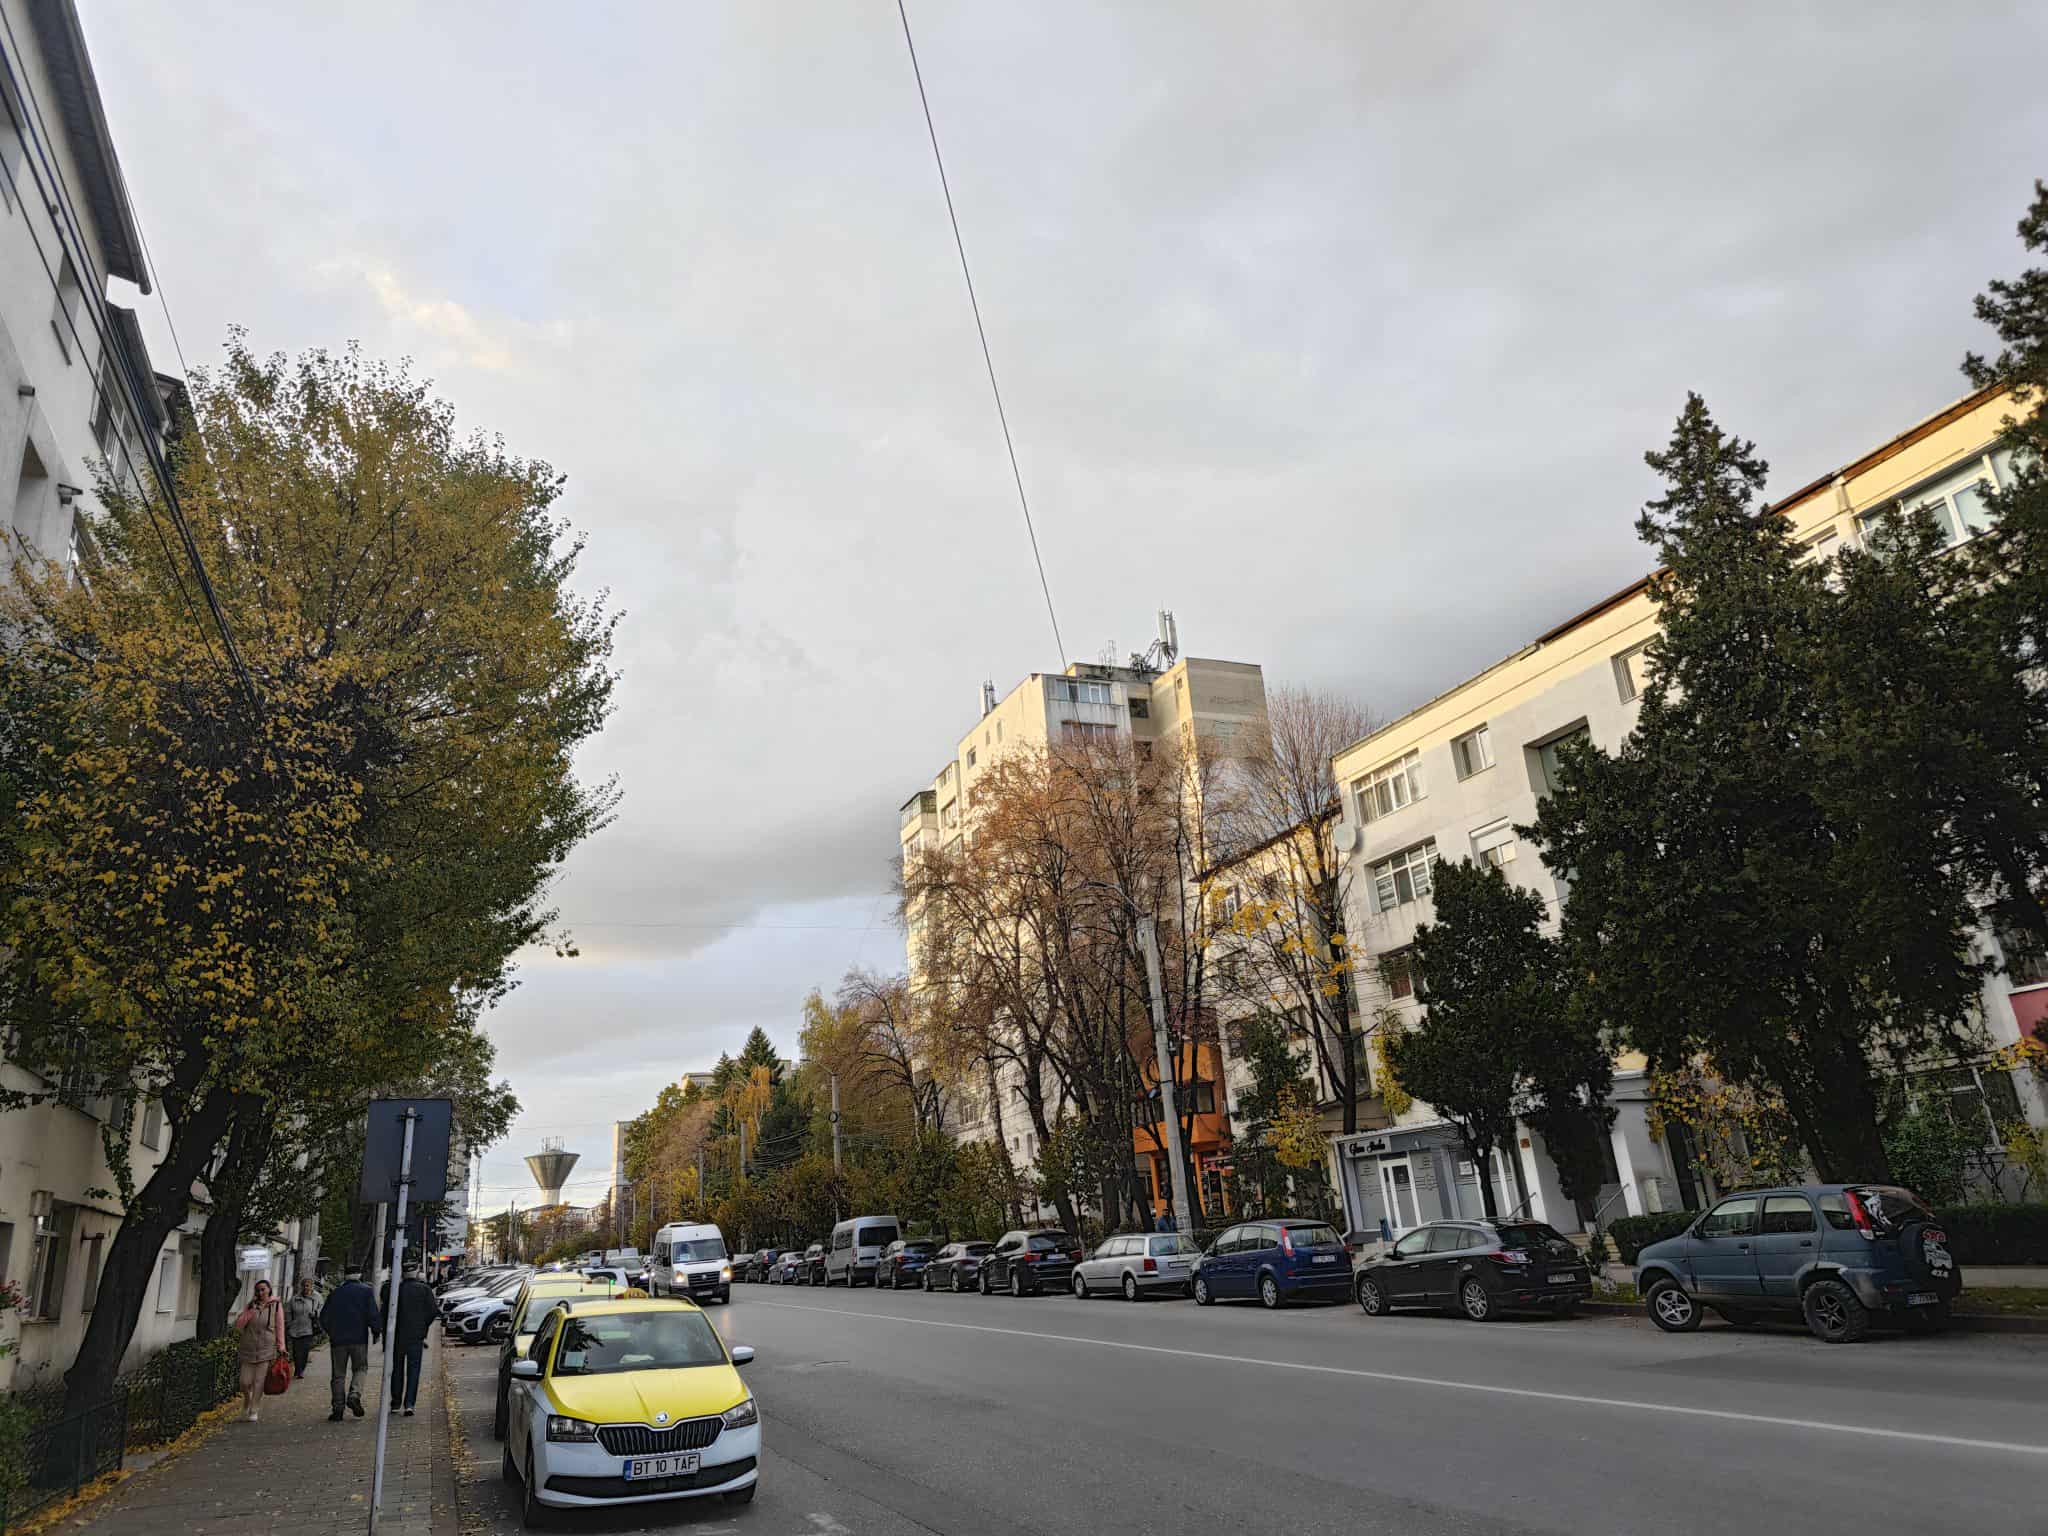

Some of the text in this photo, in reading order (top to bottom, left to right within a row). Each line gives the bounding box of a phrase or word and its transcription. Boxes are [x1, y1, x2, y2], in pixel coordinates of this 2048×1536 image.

[633, 1456, 697, 1475] BT 10 TAF
